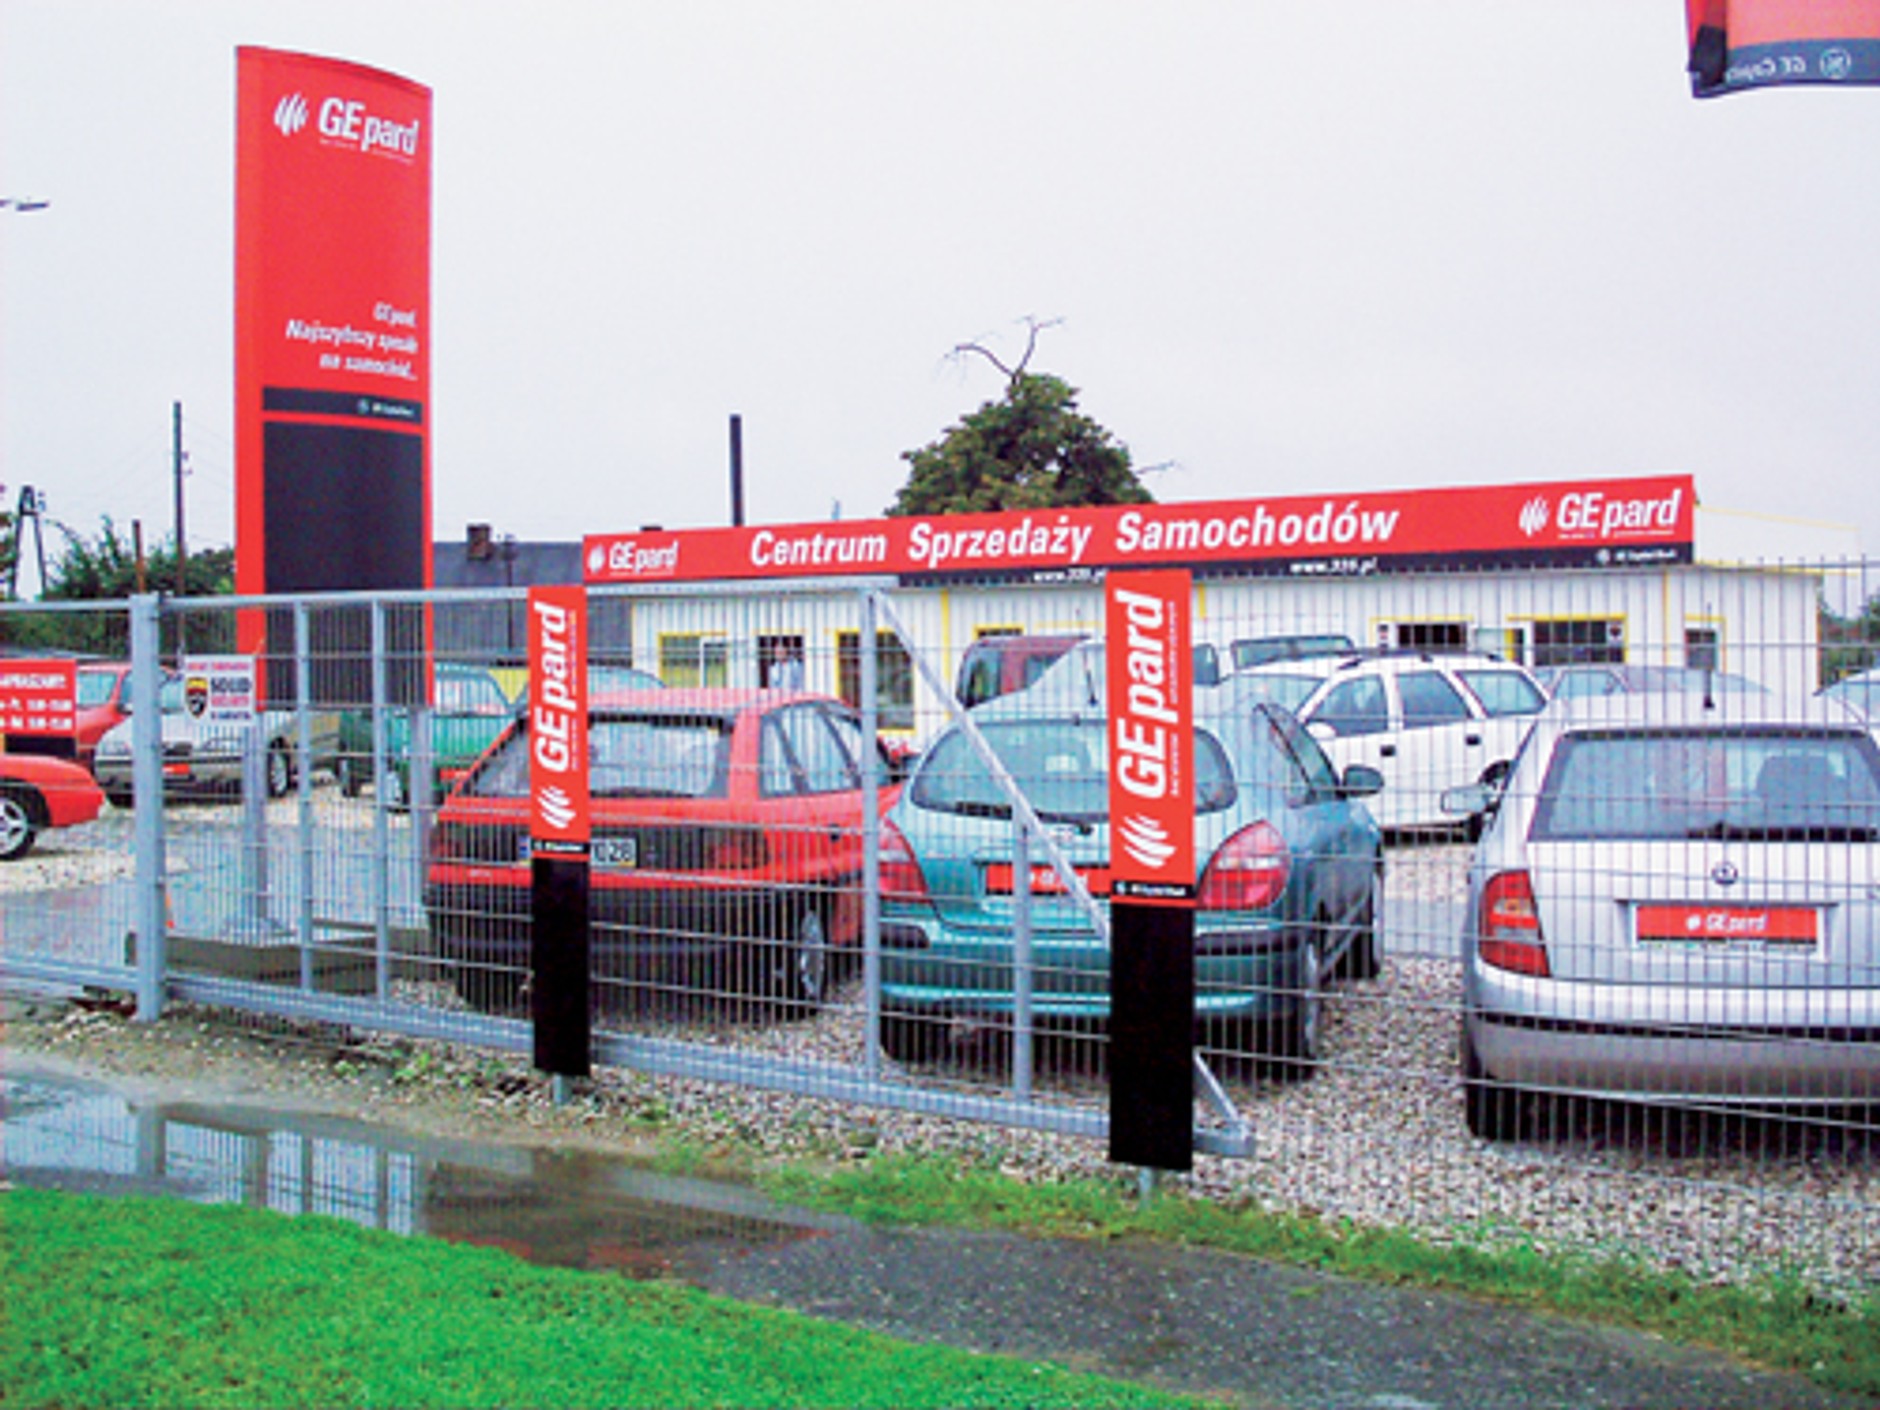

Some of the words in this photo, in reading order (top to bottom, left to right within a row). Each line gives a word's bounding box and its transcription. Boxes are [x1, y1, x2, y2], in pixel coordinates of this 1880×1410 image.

[318, 96, 420, 156] GEpard
[609, 539, 679, 574] GEpard
[750, 528, 887, 568] Centrum
[908, 514, 1091, 568] Sprzedaży
[1115, 502, 1399, 552] Samochodów
[1557, 488, 1682, 538] GEpard
[534, 601, 578, 773] GEpard
[1114, 587, 1180, 799] GEpard
